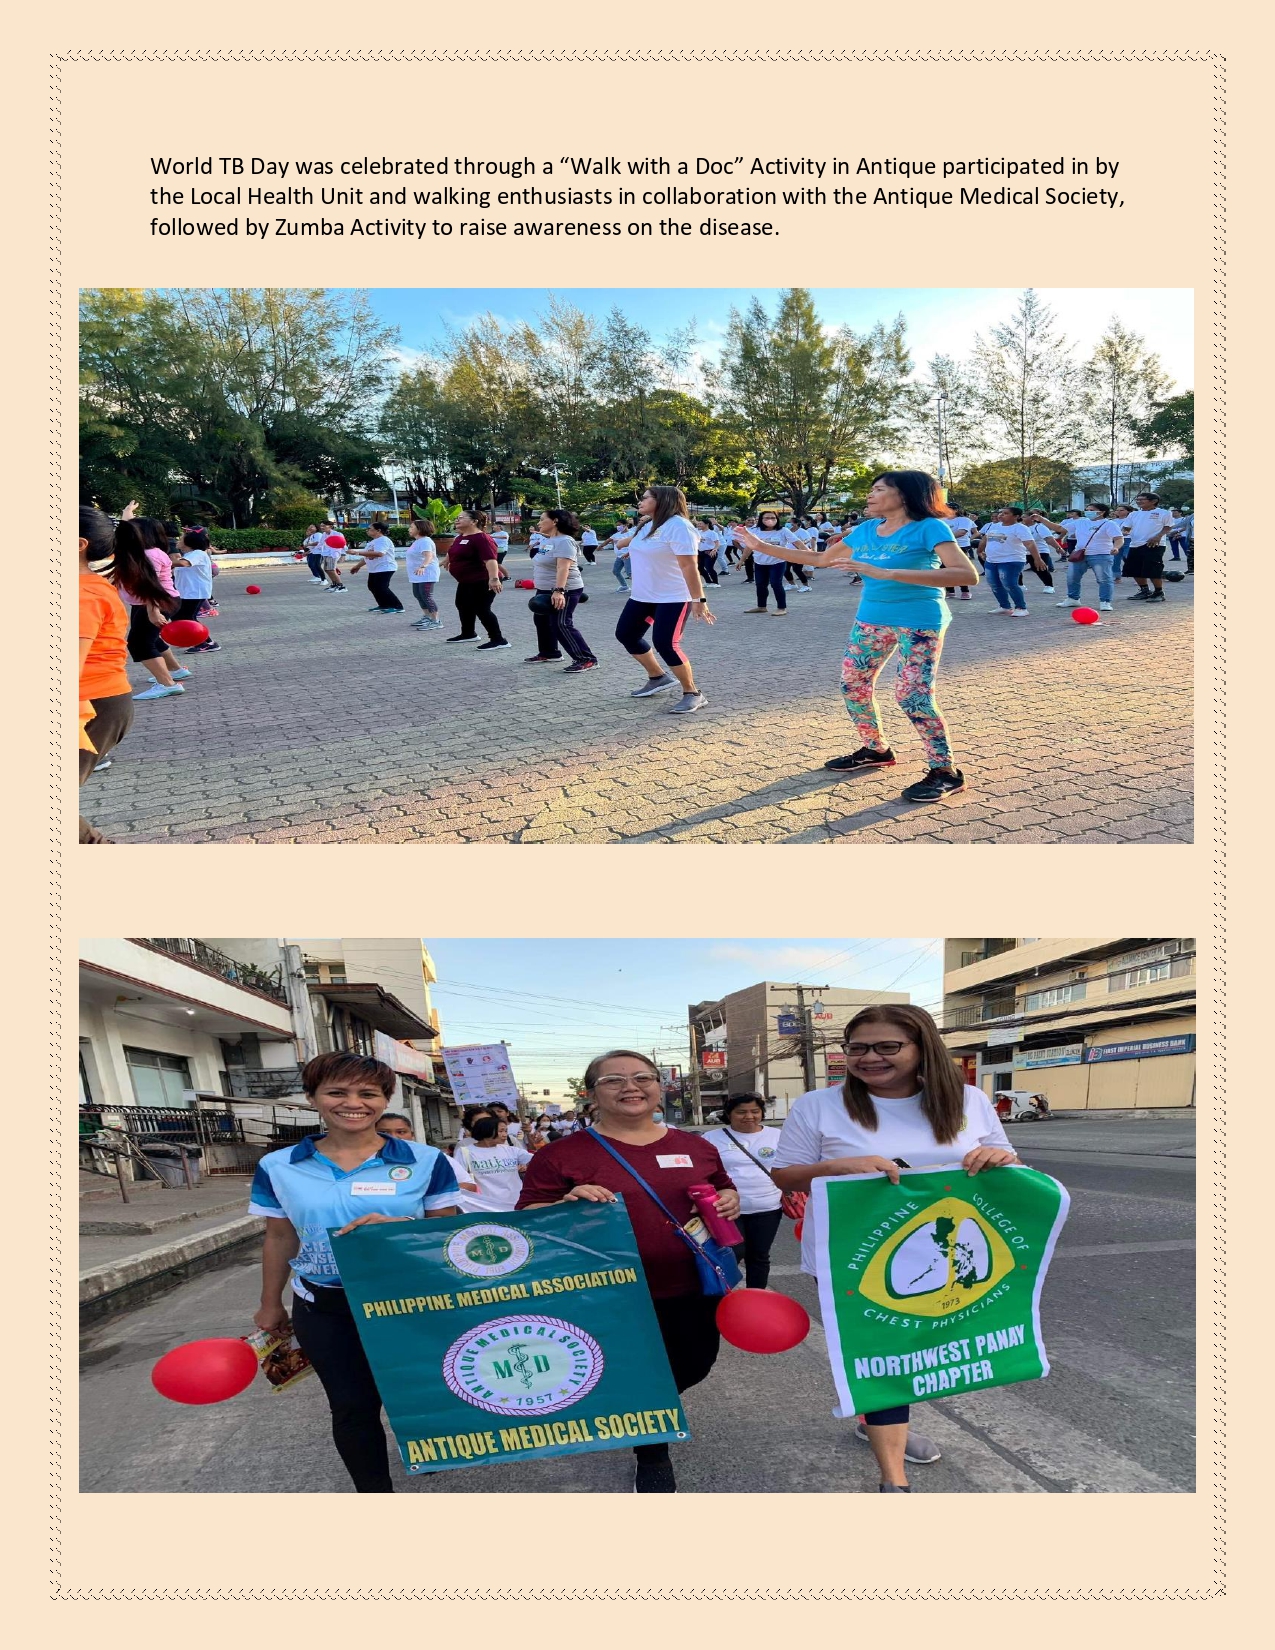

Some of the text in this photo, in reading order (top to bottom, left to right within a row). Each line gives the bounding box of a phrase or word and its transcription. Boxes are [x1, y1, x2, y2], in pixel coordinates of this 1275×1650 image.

[1103, 1046, 1117, 1055] FIRST
[1117, 1044, 1141, 1053] IMPERIAL
[1142, 1040, 1169, 1050] BUSINESS
[1169, 1038, 1187, 1047] BANK
[847, 1193, 1030, 1270] PHILIPPINE COLLEGE OF
[471, 1249, 483, 1257] M
[362, 1267, 637, 1319] PHILIPPINE MEDICAL ASSOCIATION
[863, 1283, 1010, 1329] CHEST PHYSICIANS
[941, 1297, 961, 1310] 1973
[460, 1325, 588, 1400] ANTIQUE MEDICAL SOCIETY
[491, 1354, 551, 1380] M D
[854, 1324, 1026, 1379] NORTHWEST PANAY
[912, 1360, 994, 1396] CHAPTER
[515, 1392, 554, 1407] 1957
[406, 1408, 681, 1464] ANTIQUE MEDICAL SOCIETY
